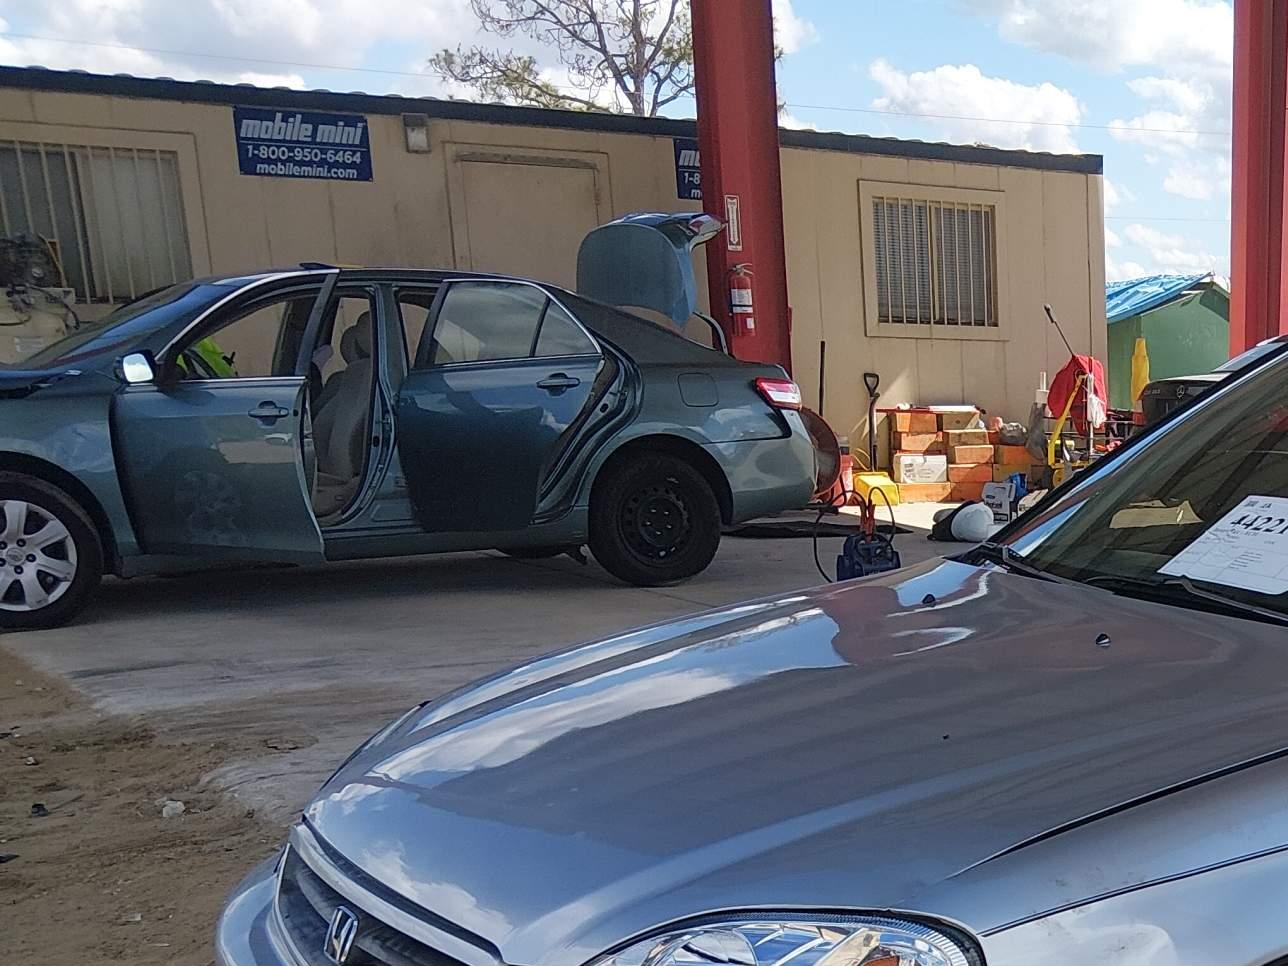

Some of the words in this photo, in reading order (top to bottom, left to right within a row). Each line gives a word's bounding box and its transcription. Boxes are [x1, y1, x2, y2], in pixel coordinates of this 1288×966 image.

[240, 112, 313, 141] mobile
[316, 121, 364, 145] mini
[247, 145, 361, 164] 1-800-950-6464
[256, 163, 358, 179] mobilemini.com
